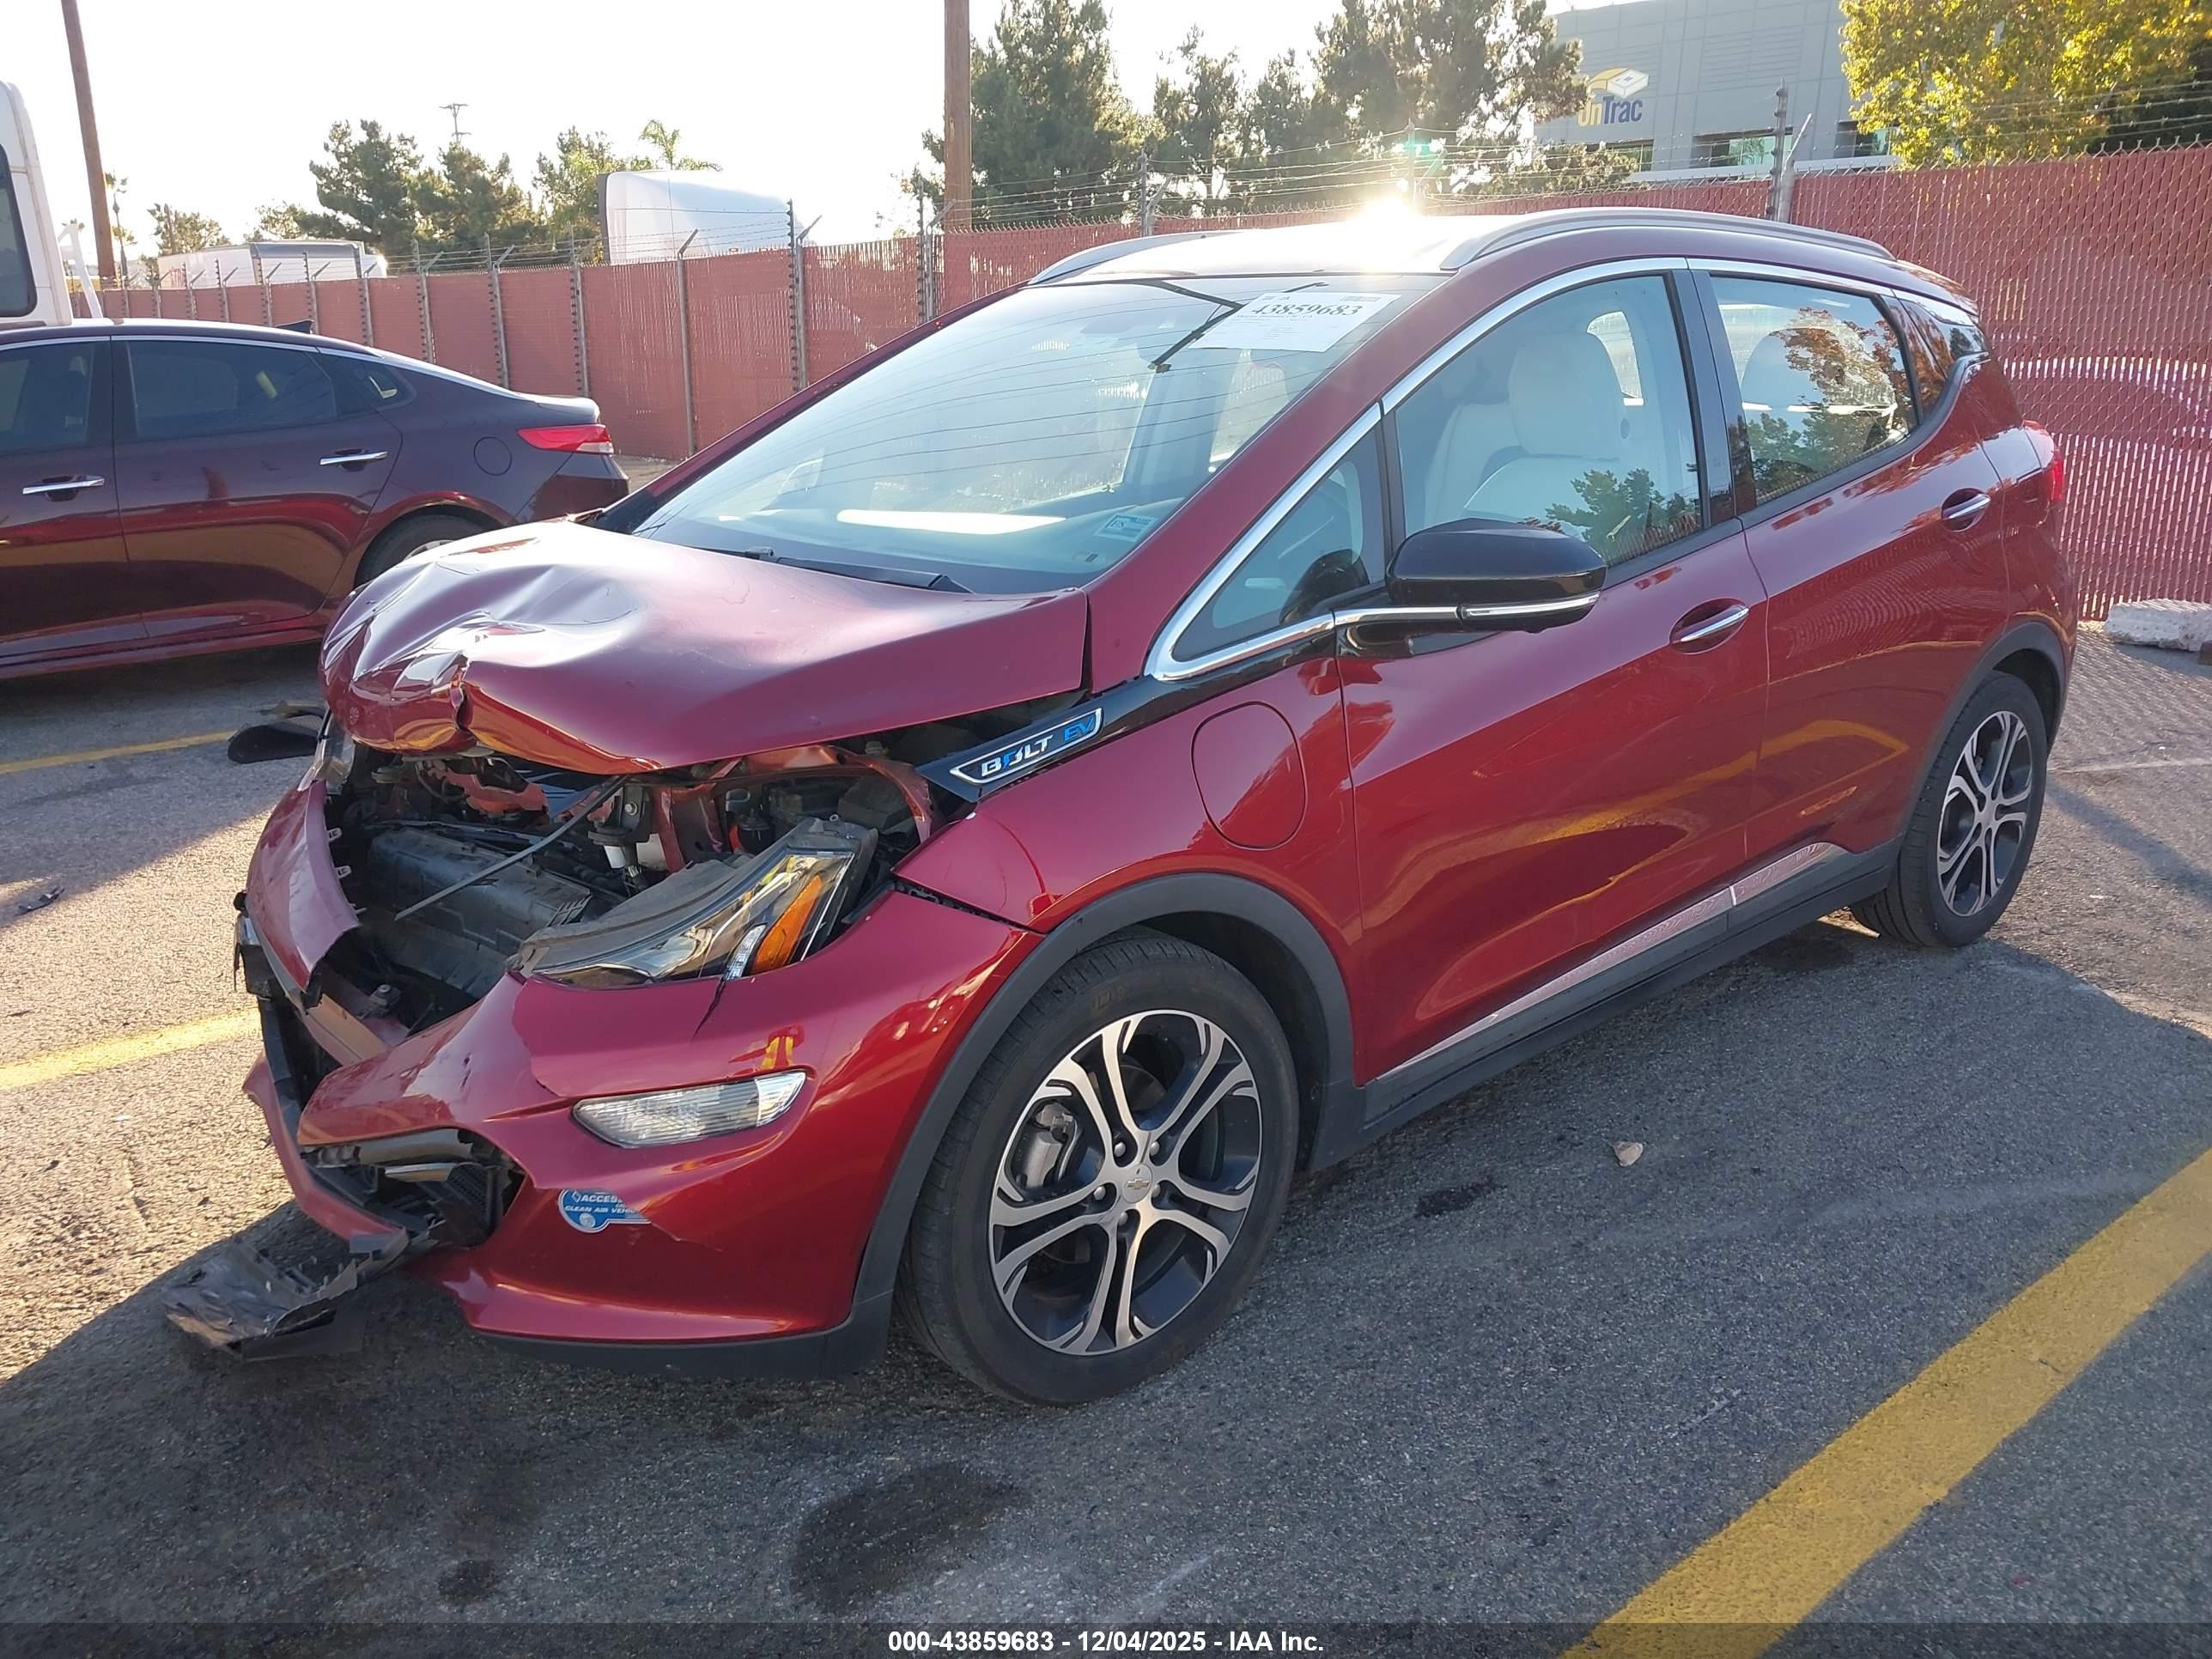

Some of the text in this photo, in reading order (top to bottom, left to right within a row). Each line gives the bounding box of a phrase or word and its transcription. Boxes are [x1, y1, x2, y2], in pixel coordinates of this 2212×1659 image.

[1251, 304, 1364, 316] 43859683
[981, 717, 1094, 777] BOLT EV
